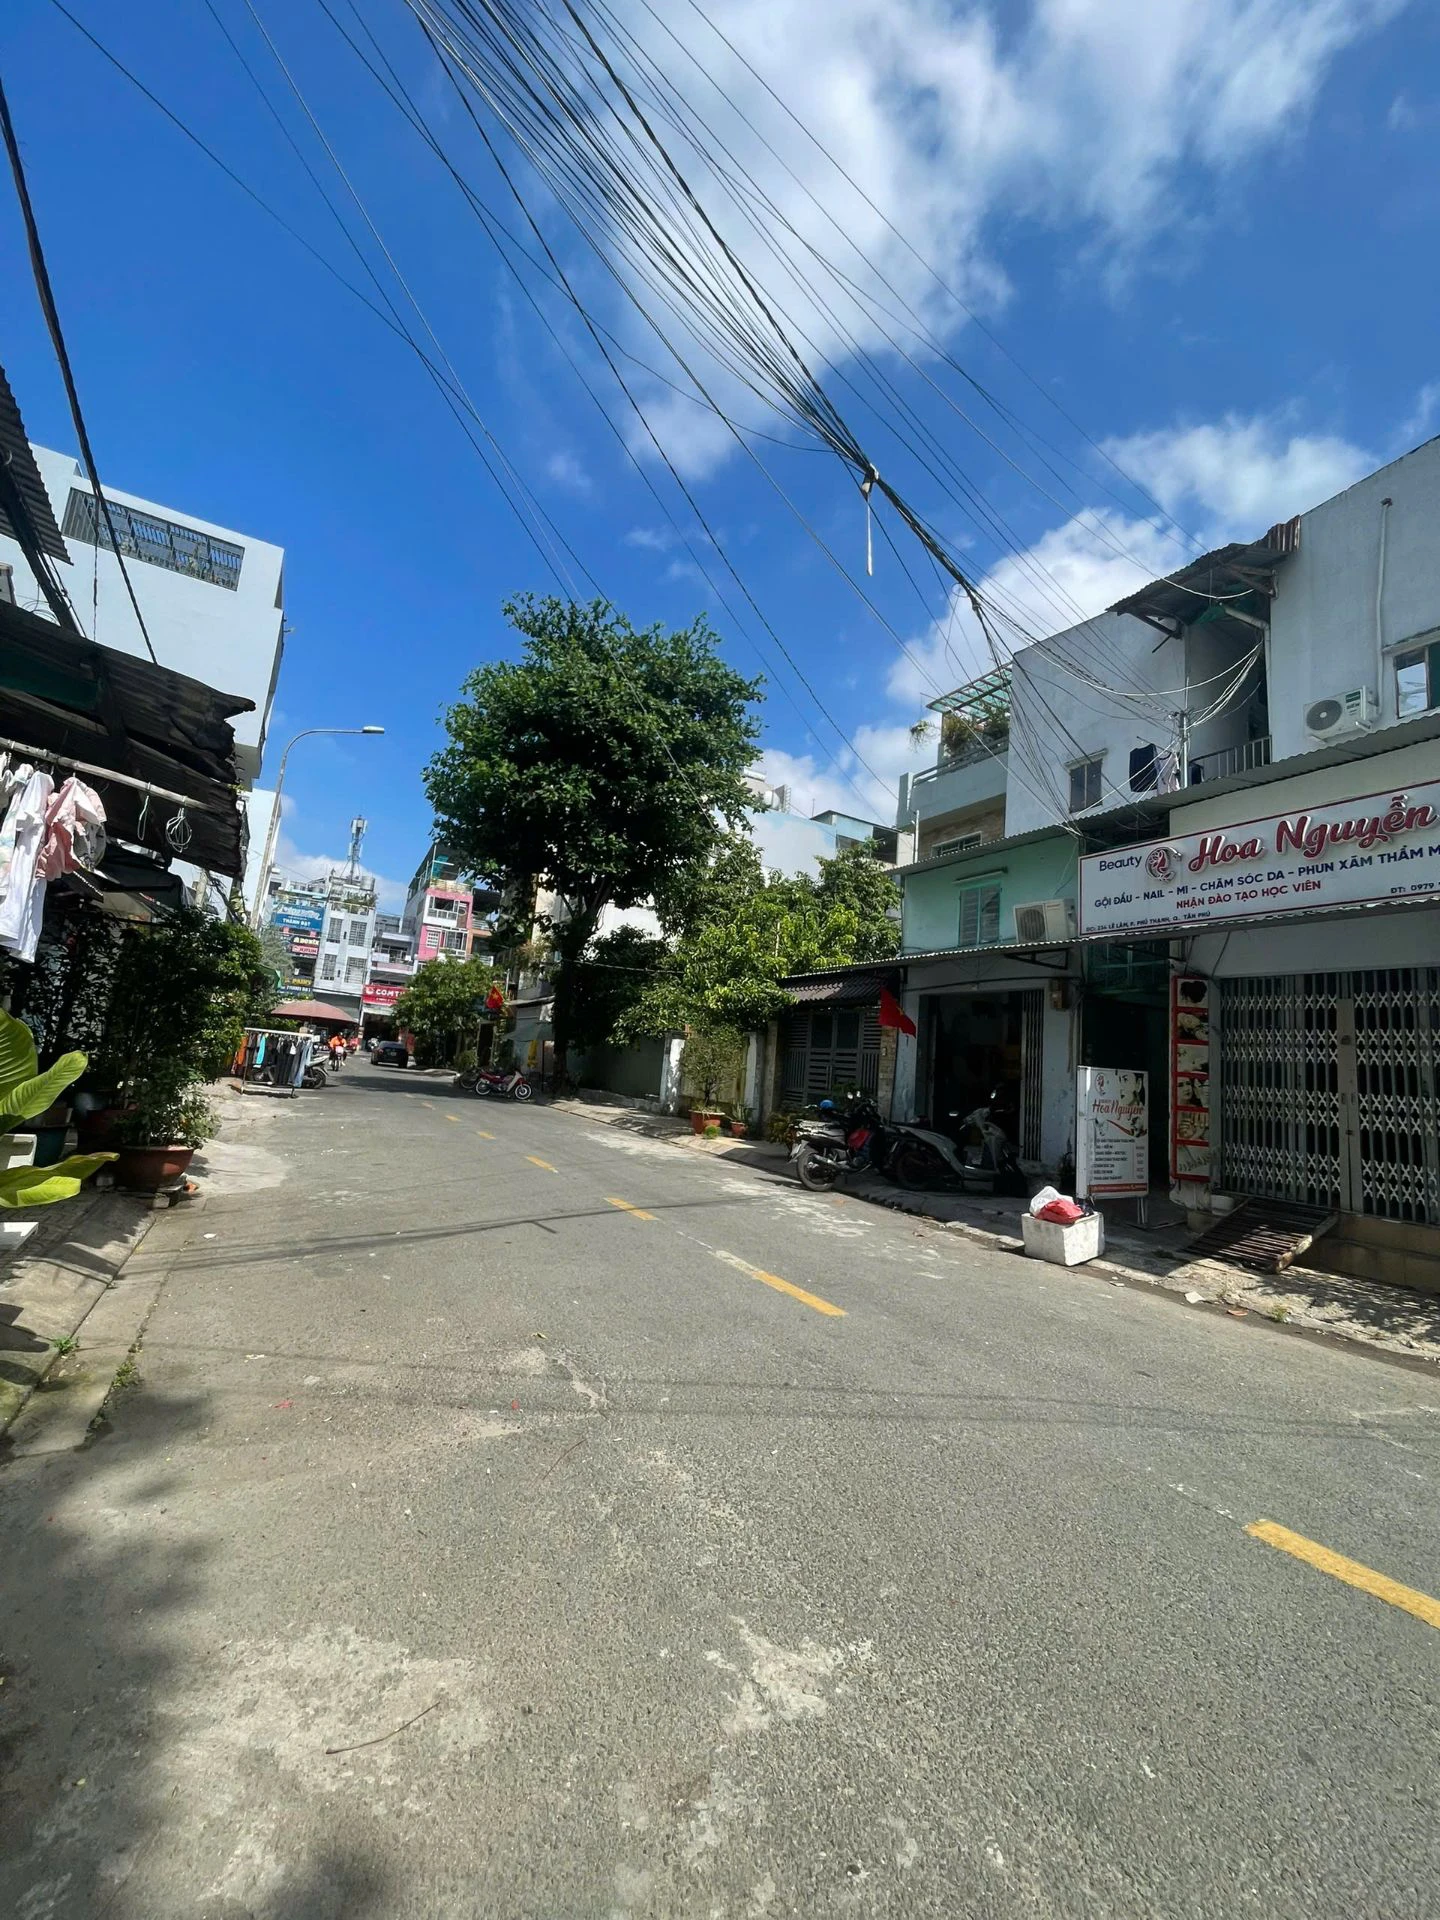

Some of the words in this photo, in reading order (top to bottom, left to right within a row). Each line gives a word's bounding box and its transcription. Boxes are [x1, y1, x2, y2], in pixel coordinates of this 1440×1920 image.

[1188, 835, 1265, 873] Hoa
[1276, 794, 1439, 859] Nguyễn
[1099, 855, 1142, 872] Beauty
[1143, 889, 1165, 901] NAIL
[1176, 885, 1188, 895] MI
[1199, 878, 1233, 891] CHĂM
[1237, 873, 1263, 885] SÓC
[1266, 870, 1285, 881] DA
[1298, 861, 1334, 877] PHUN
[1338, 855, 1373, 871] XĂM
[1176, 897, 1205, 909] NHẬN
[1208, 893, 1232, 905] ĐÀO
[1235, 889, 1258, 903] TẠO
[1261, 885, 1288, 898] HỌC
[1293, 880, 1321, 893] VIÊN
[1410, 882, 1435, 891] 0979
